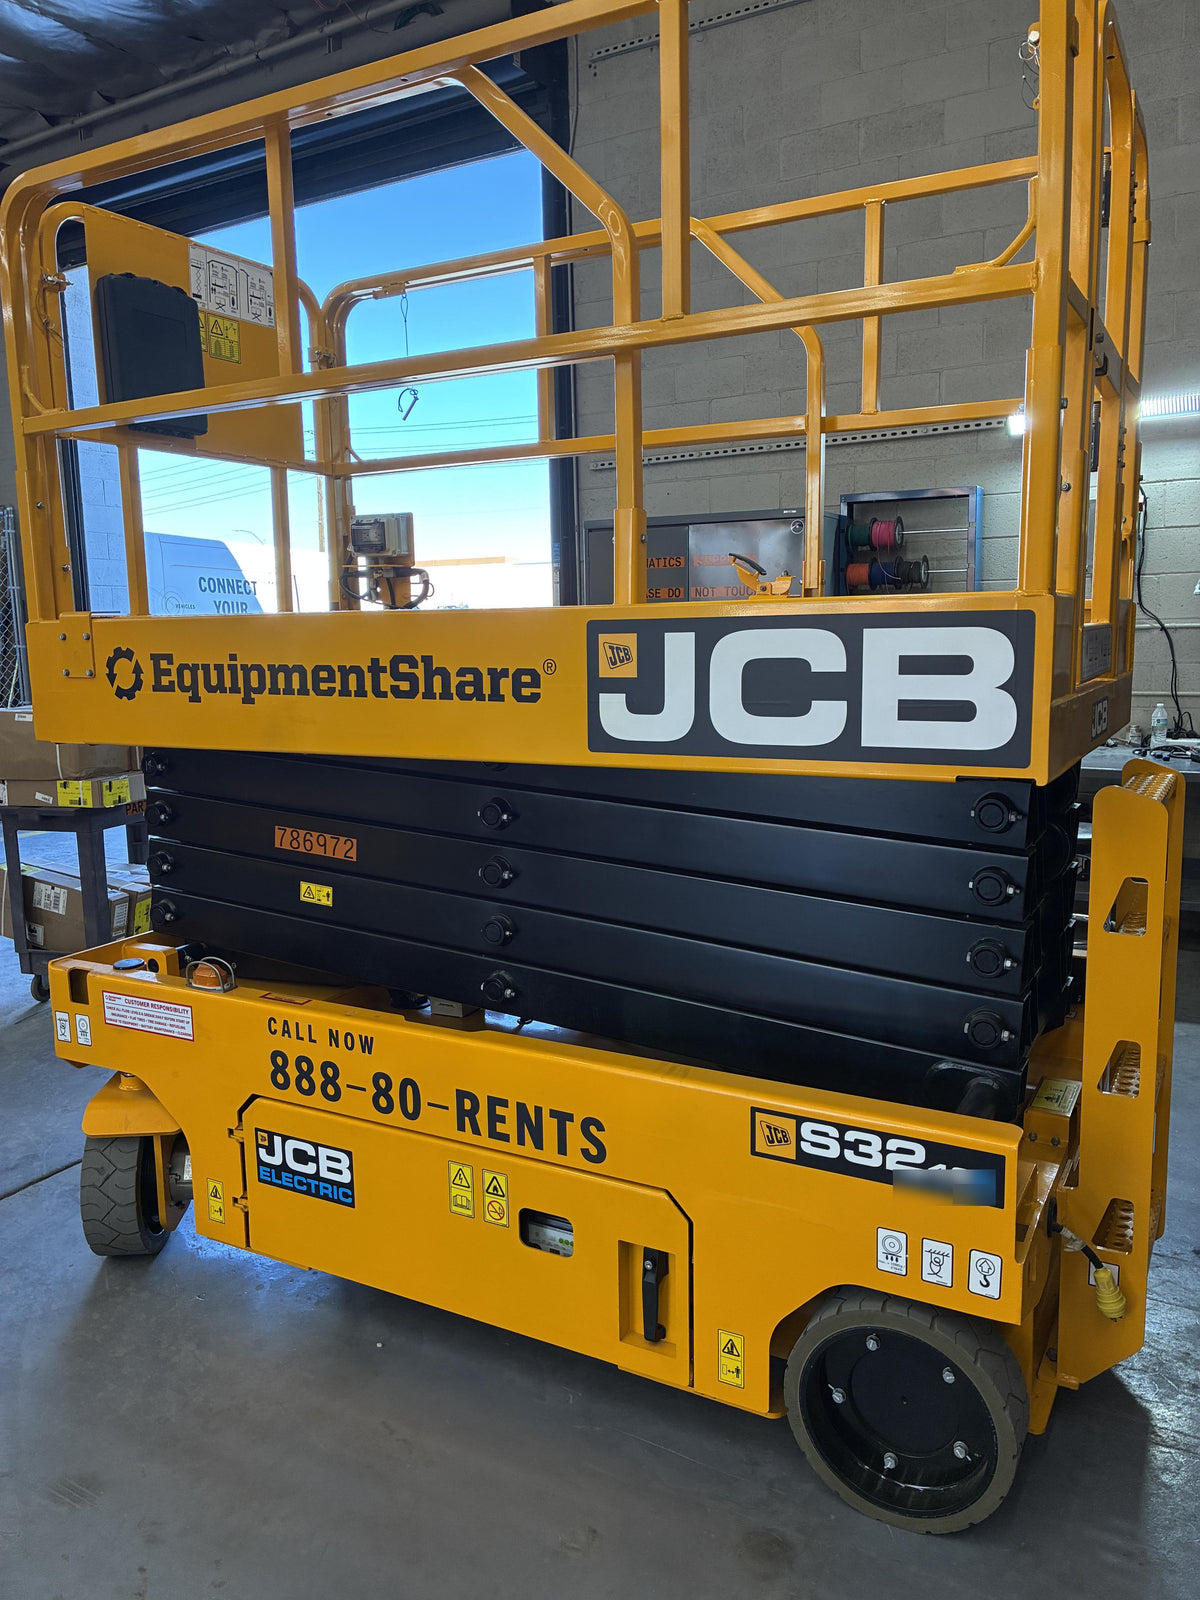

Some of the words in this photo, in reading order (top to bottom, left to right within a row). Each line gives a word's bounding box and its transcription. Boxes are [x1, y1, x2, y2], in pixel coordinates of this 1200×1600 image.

[646, 557, 682, 568] ATICS
[198, 576, 257, 596] CONNECT
[667, 588, 681, 598] DO
[694, 587, 716, 597] NOT
[607, 645, 631, 666] JCB
[599, 626, 1018, 751] JCB
[277, 827, 355, 859] 786972
[124, 997, 149, 1008] CUSTOMER
[150, 1002, 188, 1015] RESPONSIBILITY
[268, 1017, 317, 1044] CALL
[328, 1028, 375, 1055] NOW
[270, 1050, 607, 1164] 888-80-RENTS
[765, 1124, 789, 1145] JCB
[258, 1135, 352, 1184] JCB
[259, 1166, 353, 1203] ELECTRIC
